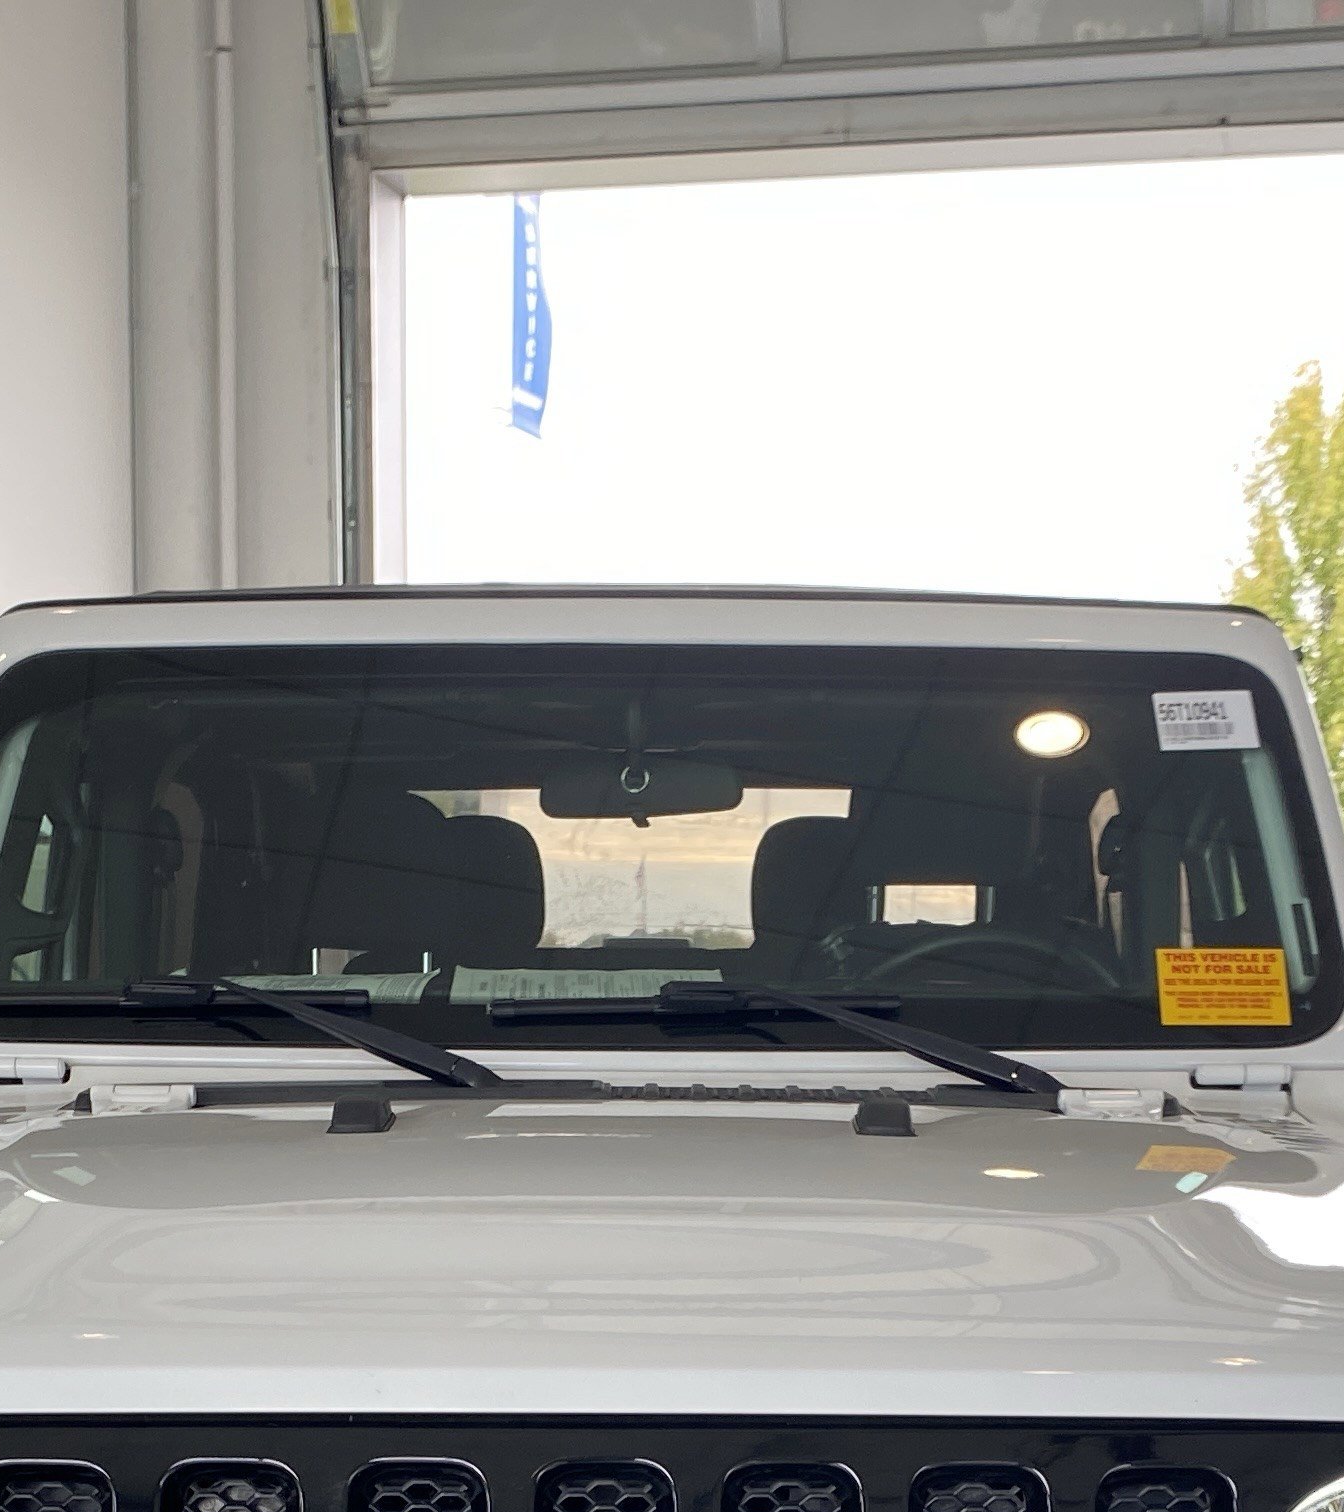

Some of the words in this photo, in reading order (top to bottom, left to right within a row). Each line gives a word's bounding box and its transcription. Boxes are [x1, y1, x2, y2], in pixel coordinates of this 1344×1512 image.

[1163, 952, 1197, 962] THIS
[1200, 953, 1260, 963] VEHICLE
[1263, 953, 1277, 963] IS
[1171, 964, 1201, 974] NOT
[1205, 964, 1233, 974] FOR
[1236, 964, 1271, 974] SALE
